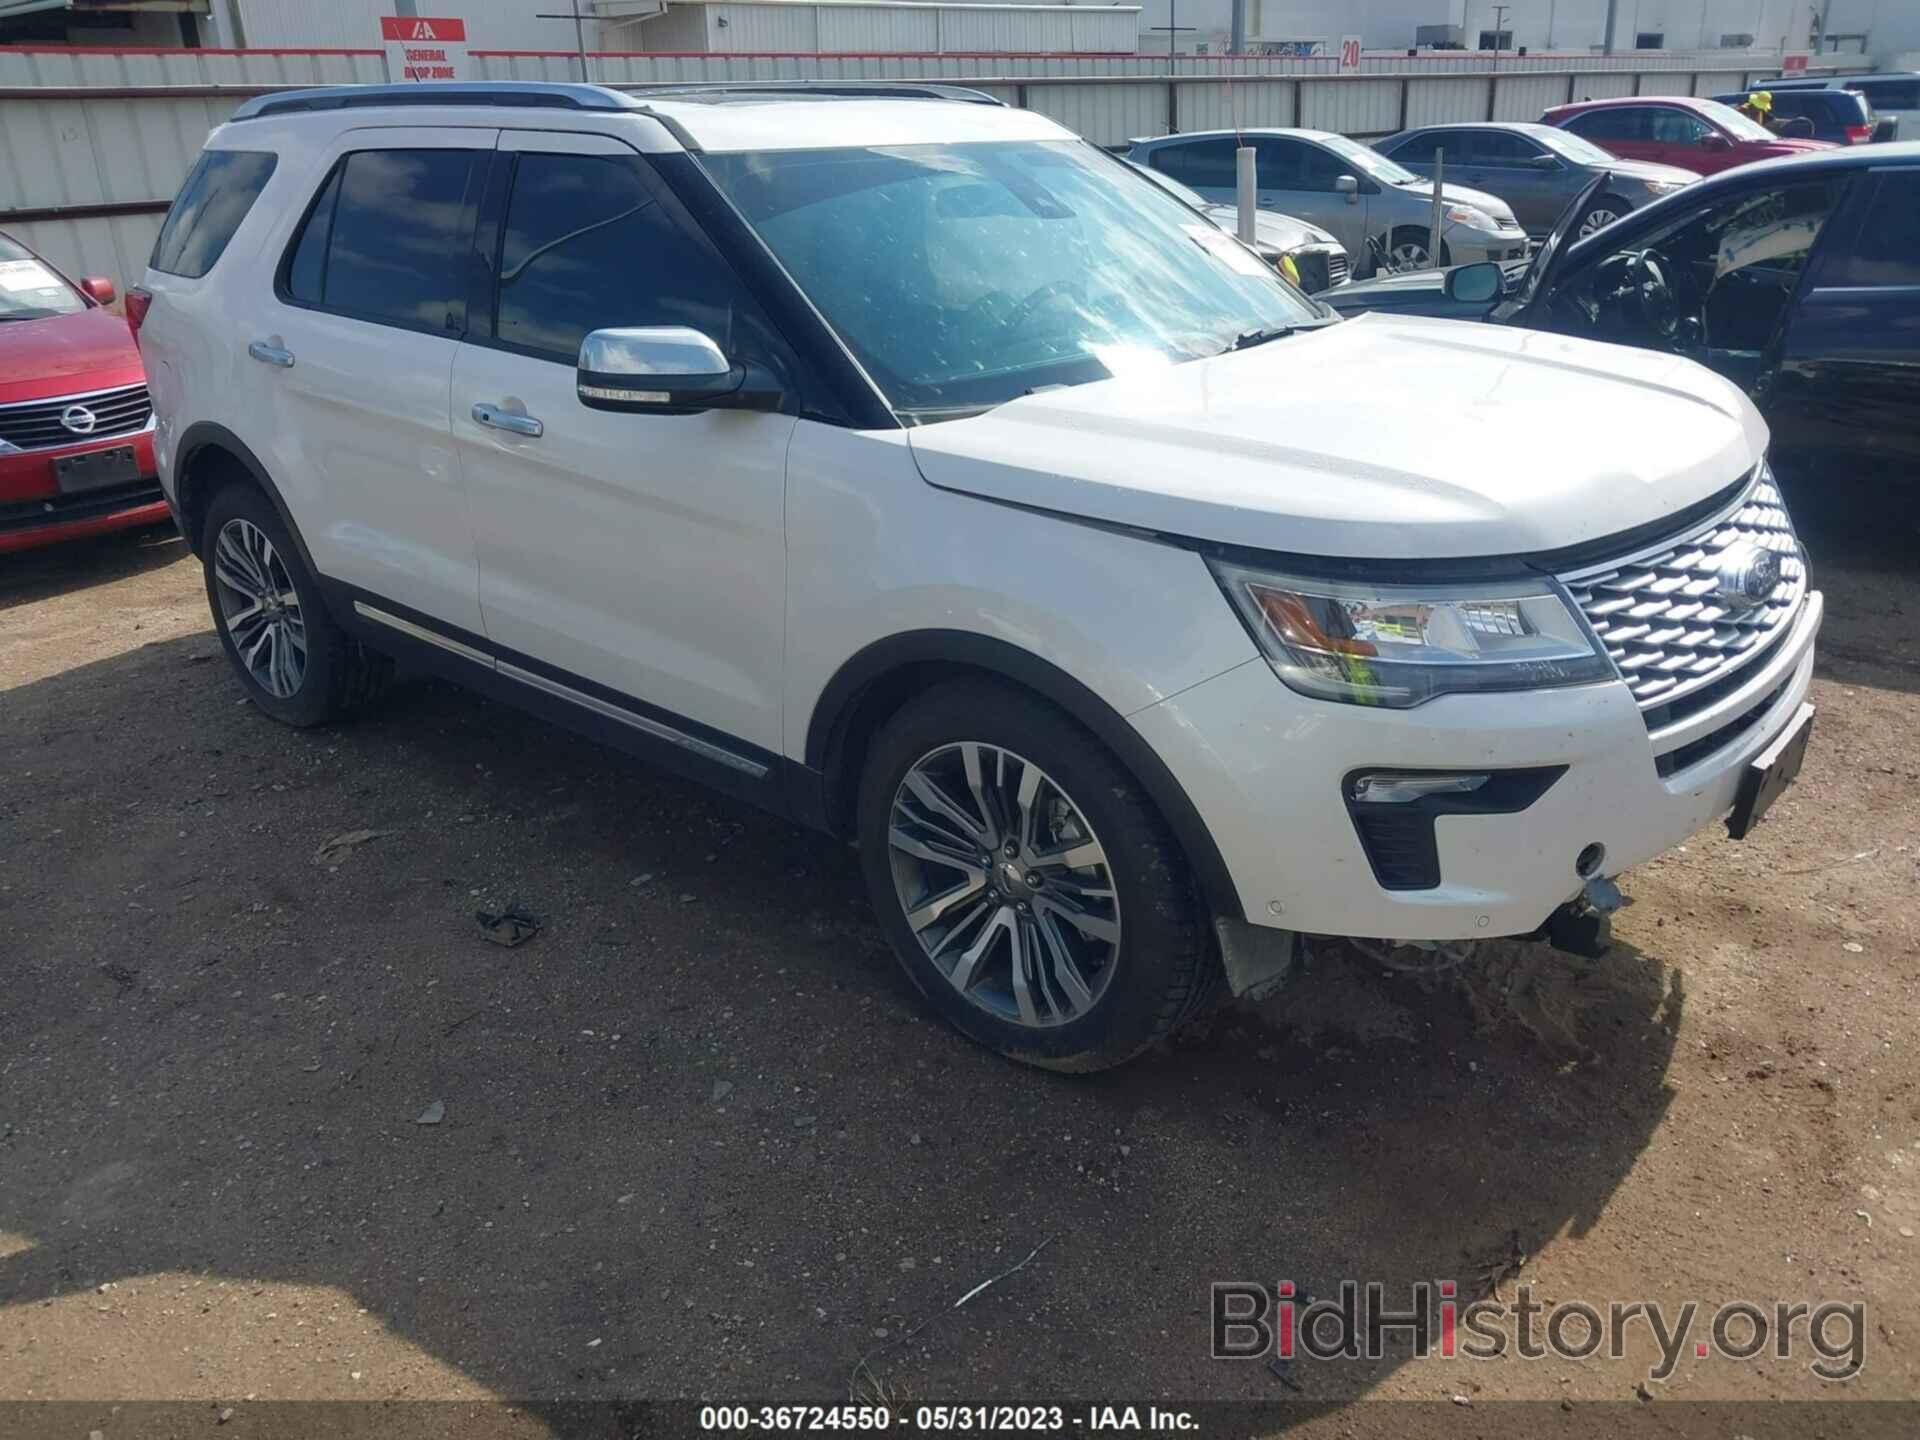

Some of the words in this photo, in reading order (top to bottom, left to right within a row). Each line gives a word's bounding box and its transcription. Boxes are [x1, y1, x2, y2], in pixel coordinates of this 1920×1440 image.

[405, 48, 447, 62] GENERAL
[1343, 40, 1360, 66] 20
[432, 66, 455, 80] ZONE
